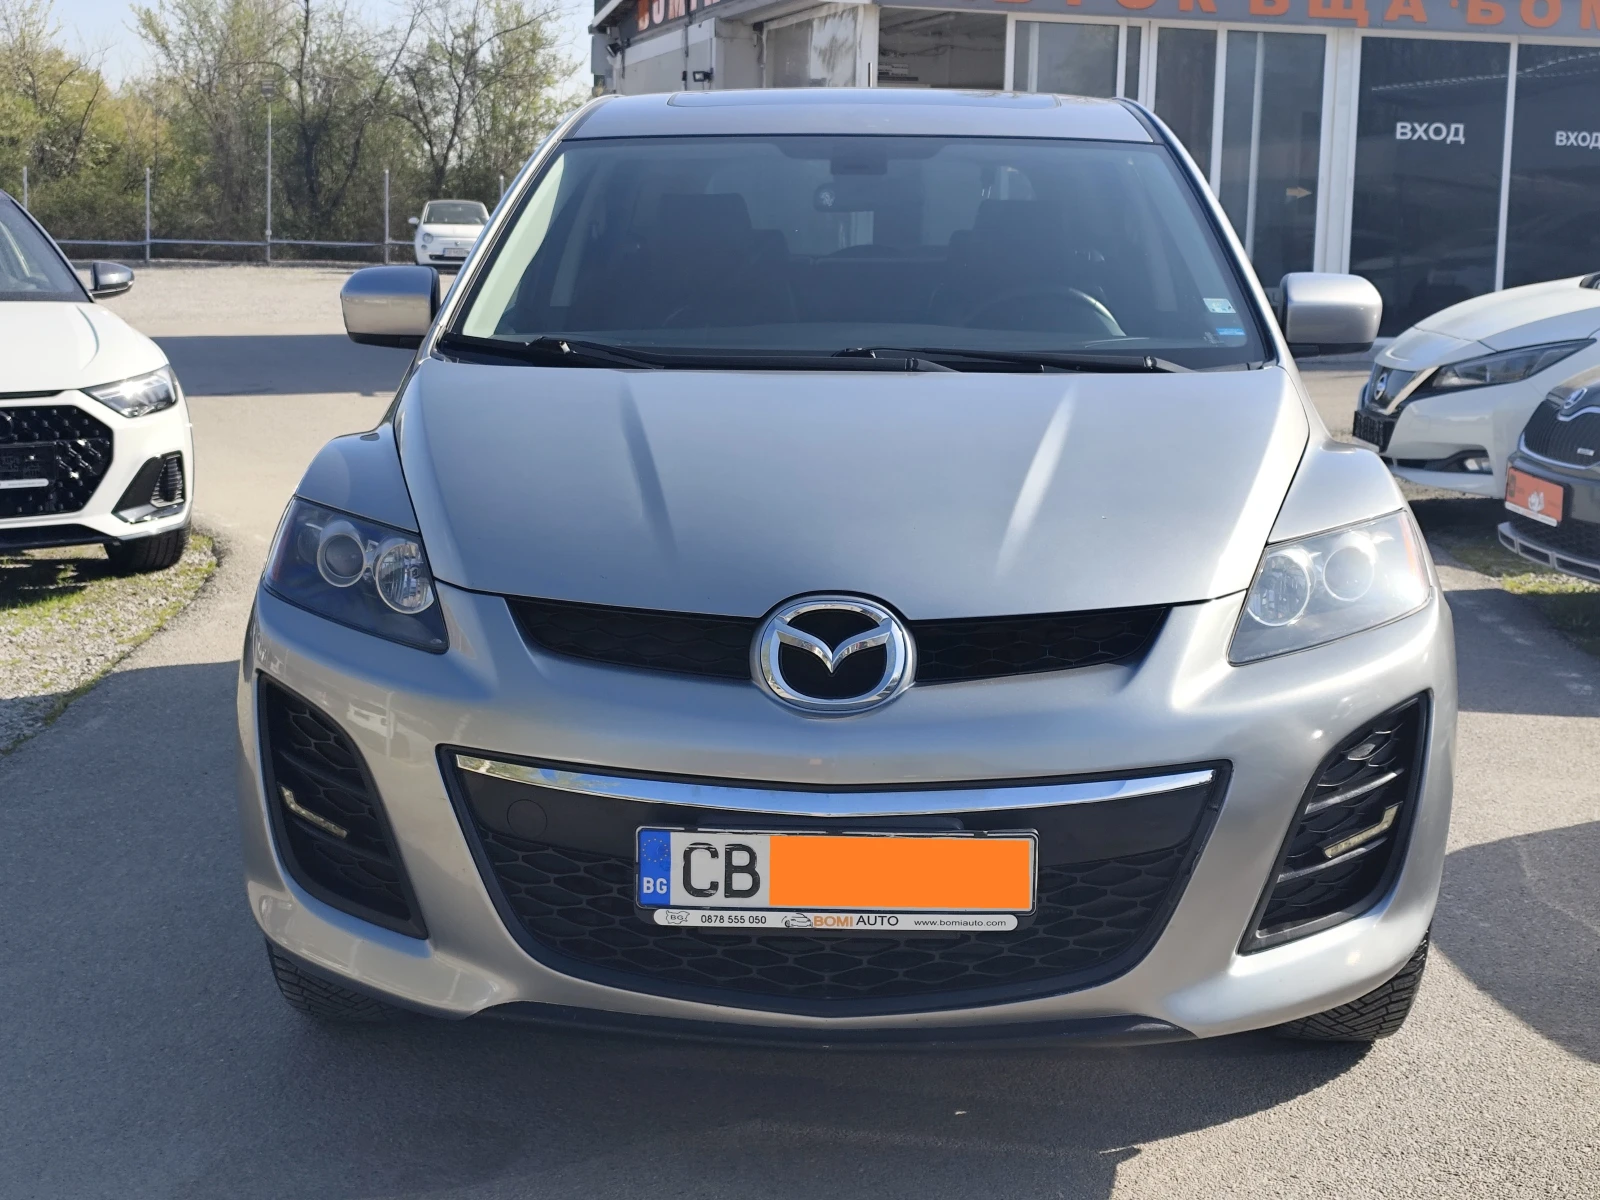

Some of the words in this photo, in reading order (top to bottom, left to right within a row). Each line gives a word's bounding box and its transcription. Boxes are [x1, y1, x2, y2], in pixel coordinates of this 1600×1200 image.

[1395, 122, 1465, 144] ВХОД
[1555, 131, 1600, 149] ВХОД
[682, 842, 761, 898] CB
[643, 877, 668, 894] BG
[700, 914, 725, 924] 0878
[727, 915, 746, 924] 555
[748, 915, 767, 925] 050
[813, 915, 853, 927] BOMI
[856, 915, 899, 926] AUTO
[914, 918, 1007, 927] www.bomiauto.com
